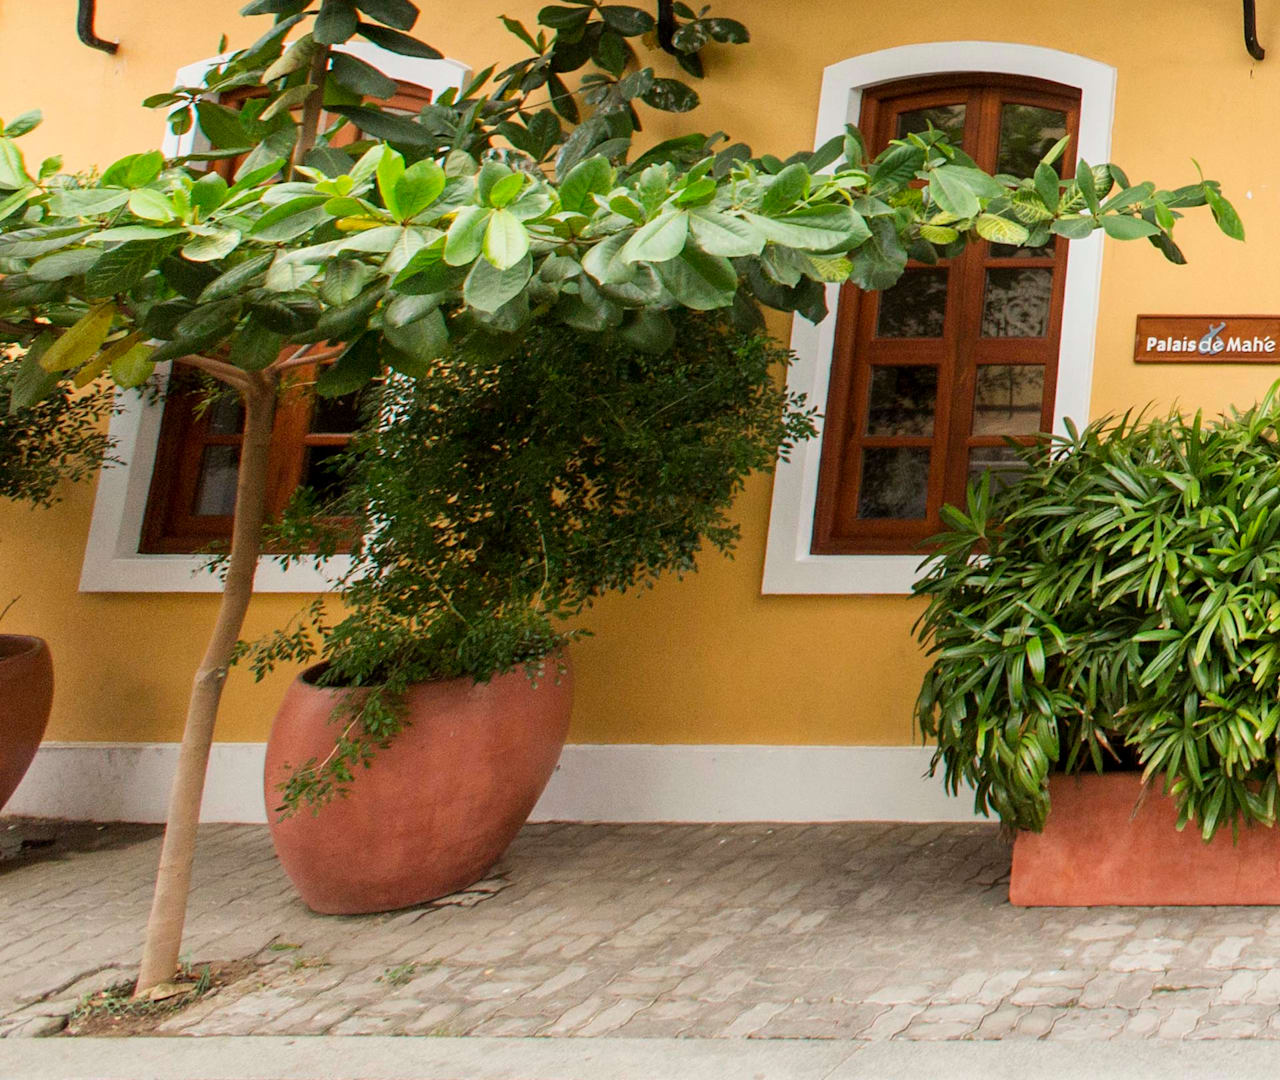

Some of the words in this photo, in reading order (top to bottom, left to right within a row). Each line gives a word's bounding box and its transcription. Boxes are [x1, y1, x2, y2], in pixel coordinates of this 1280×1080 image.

[1146, 336, 1197, 352] Palais
[1198, 336, 1225, 353] de
[1226, 335, 1277, 353] Mahé
